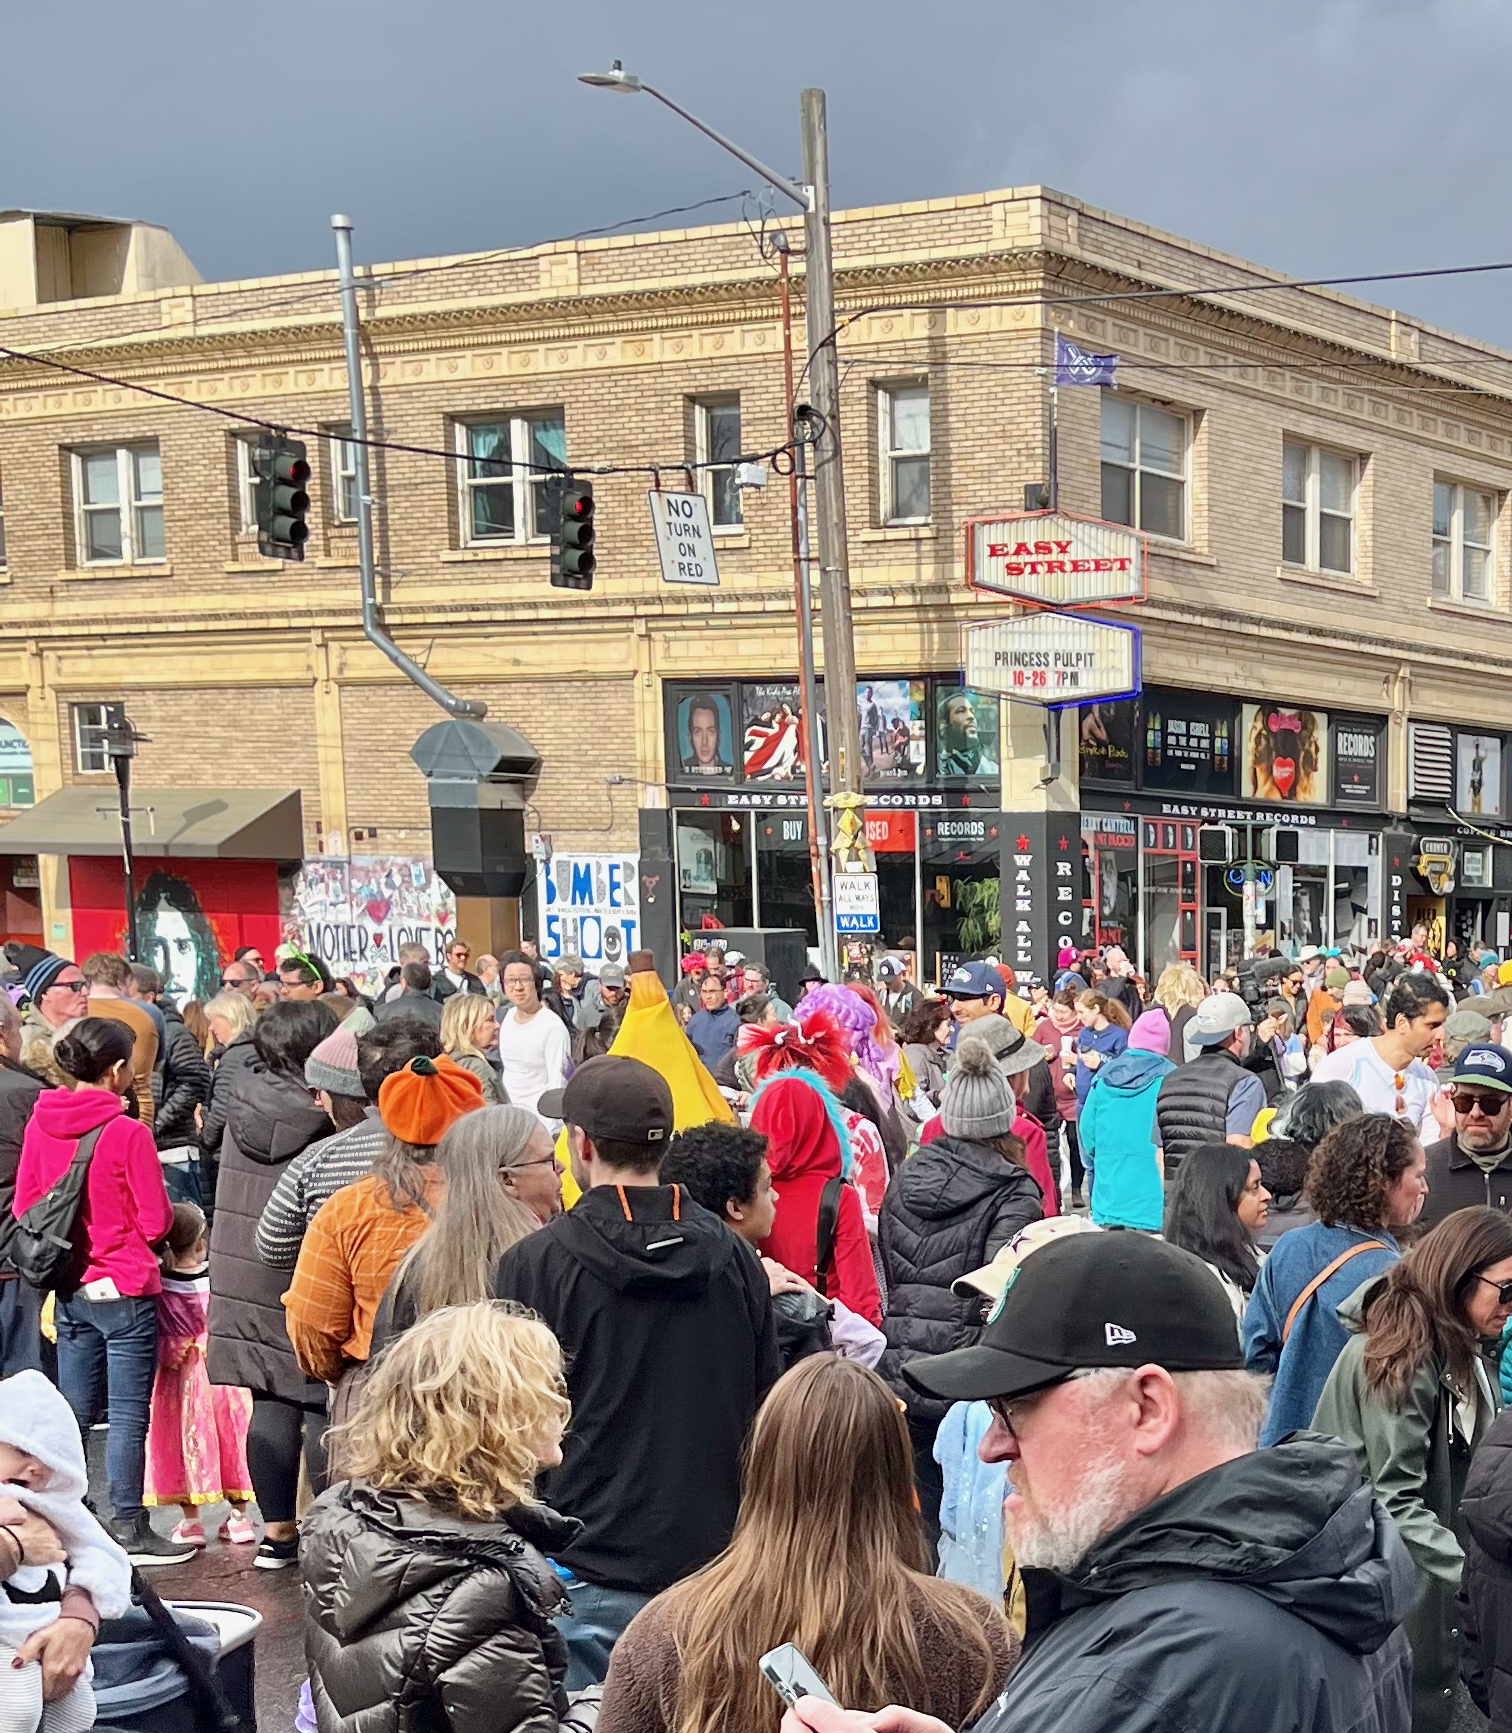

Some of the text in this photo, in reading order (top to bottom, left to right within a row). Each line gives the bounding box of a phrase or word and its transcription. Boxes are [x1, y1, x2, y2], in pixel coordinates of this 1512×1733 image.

[666, 498, 693, 519] NO
[665, 521, 702, 539] TURN
[678, 542, 697, 558] ON
[986, 540, 1074, 558] EASY
[677, 561, 704, 577] RED
[1005, 557, 1133, 577] STREET
[994, 651, 1096, 668] PRINCESS PULPIT
[1012, 670, 1080, 687] 10-26 7PM
[1337, 732, 1376, 758] RECORDS
[727, 794, 773, 806] EASY
[865, 794, 943, 806] ECORDS
[1161, 803, 1317, 826] EASY STREET RECORDS
[782, 820, 803, 840] BUY
[937, 821, 985, 836] RECORDS
[545, 859, 636, 908] BUMBER
[839, 881, 872, 891] WALK
[1012, 853, 1034, 912] WALK
[838, 894, 875, 902] ALL WAYS
[839, 915, 875, 928] WALK
[308, 921, 369, 962] MOTHER
[1014, 919, 1033, 963] ALL
